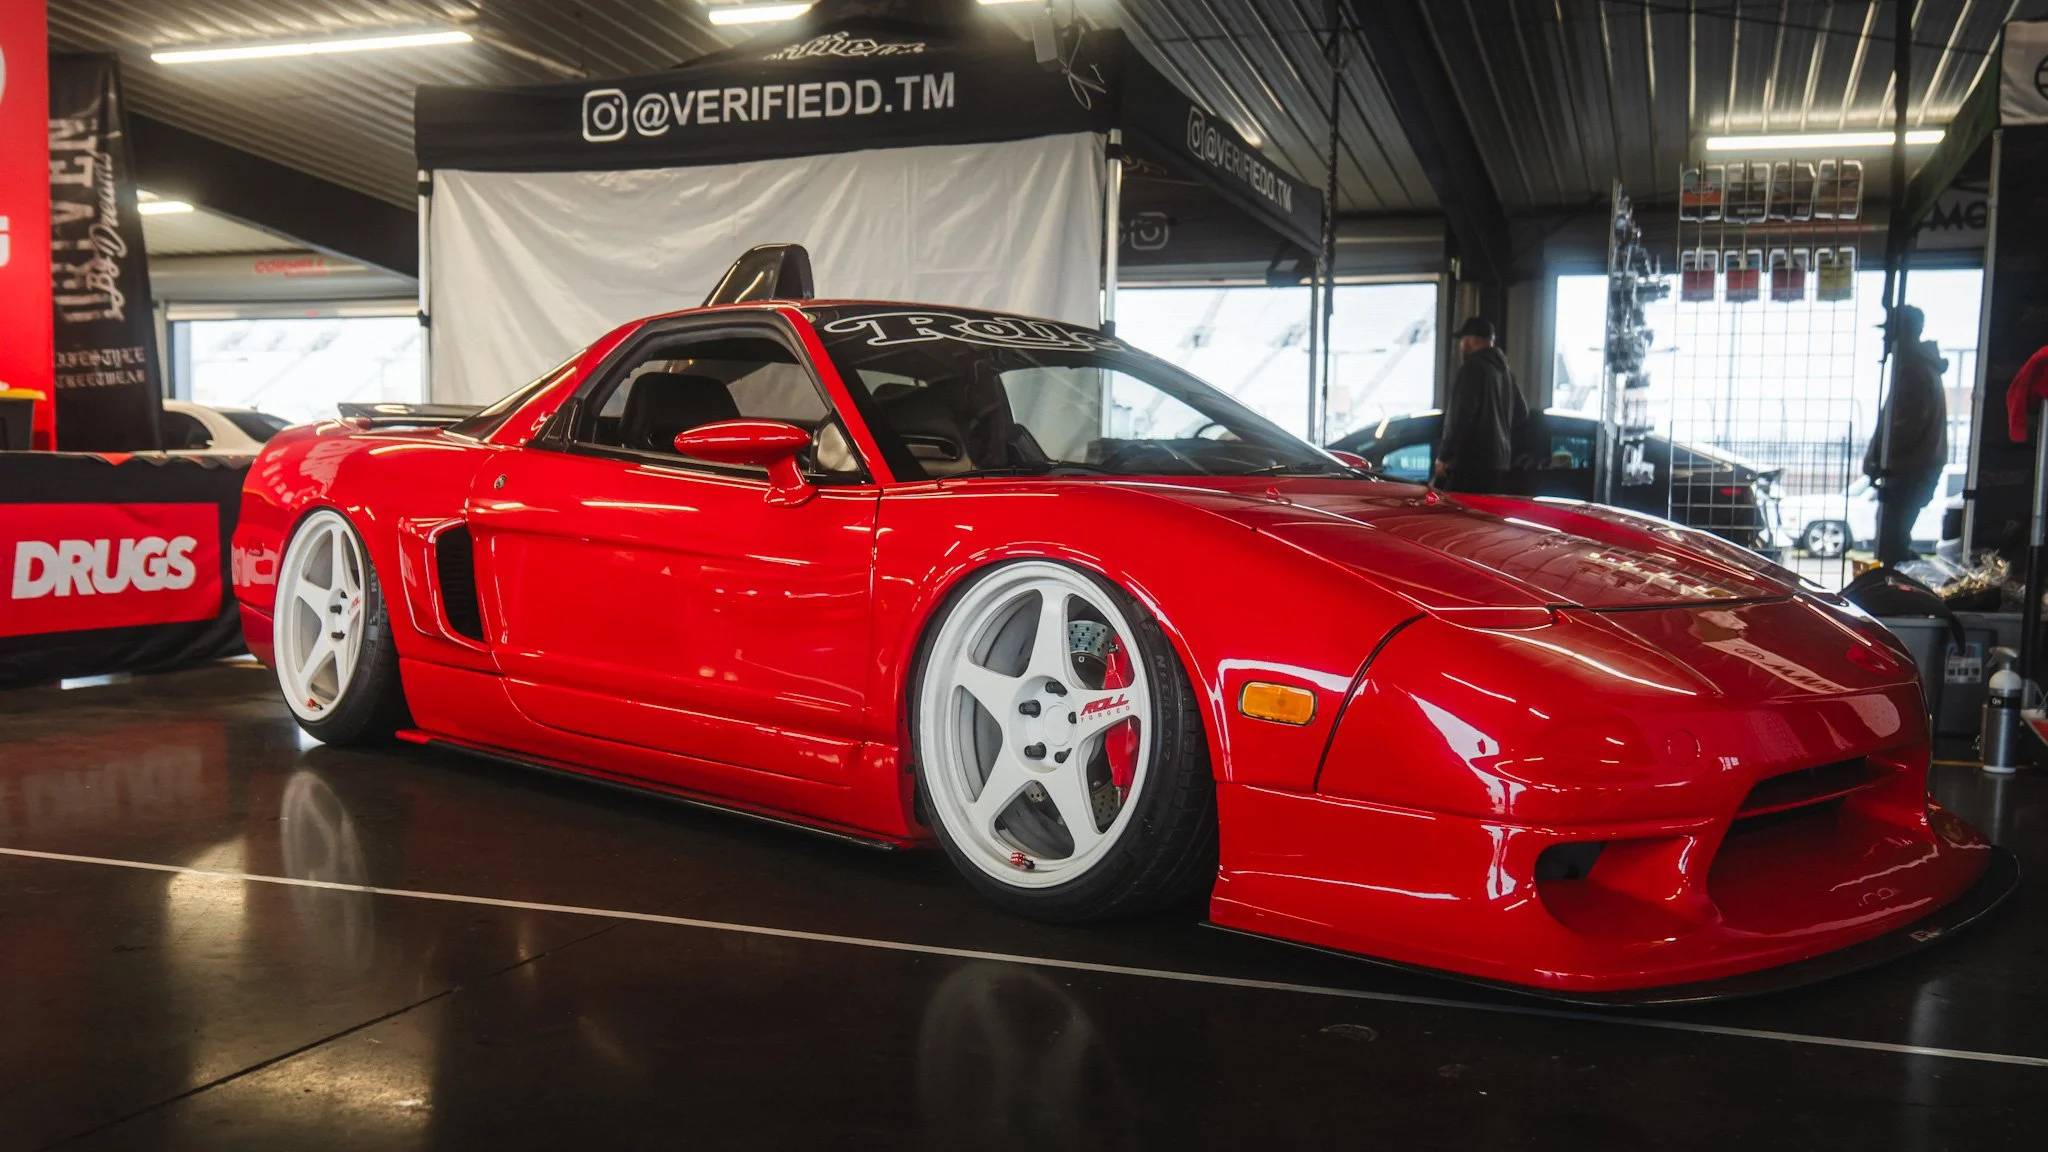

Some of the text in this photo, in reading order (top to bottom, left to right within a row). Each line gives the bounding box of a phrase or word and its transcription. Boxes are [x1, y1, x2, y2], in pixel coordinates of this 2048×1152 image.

[633, 72, 956, 138] @VERIFIEDD.TM
[11, 535, 198, 600] DRUGS
[1080, 693, 1129, 716] ROLL
[1080, 706, 1130, 723] FORGED
